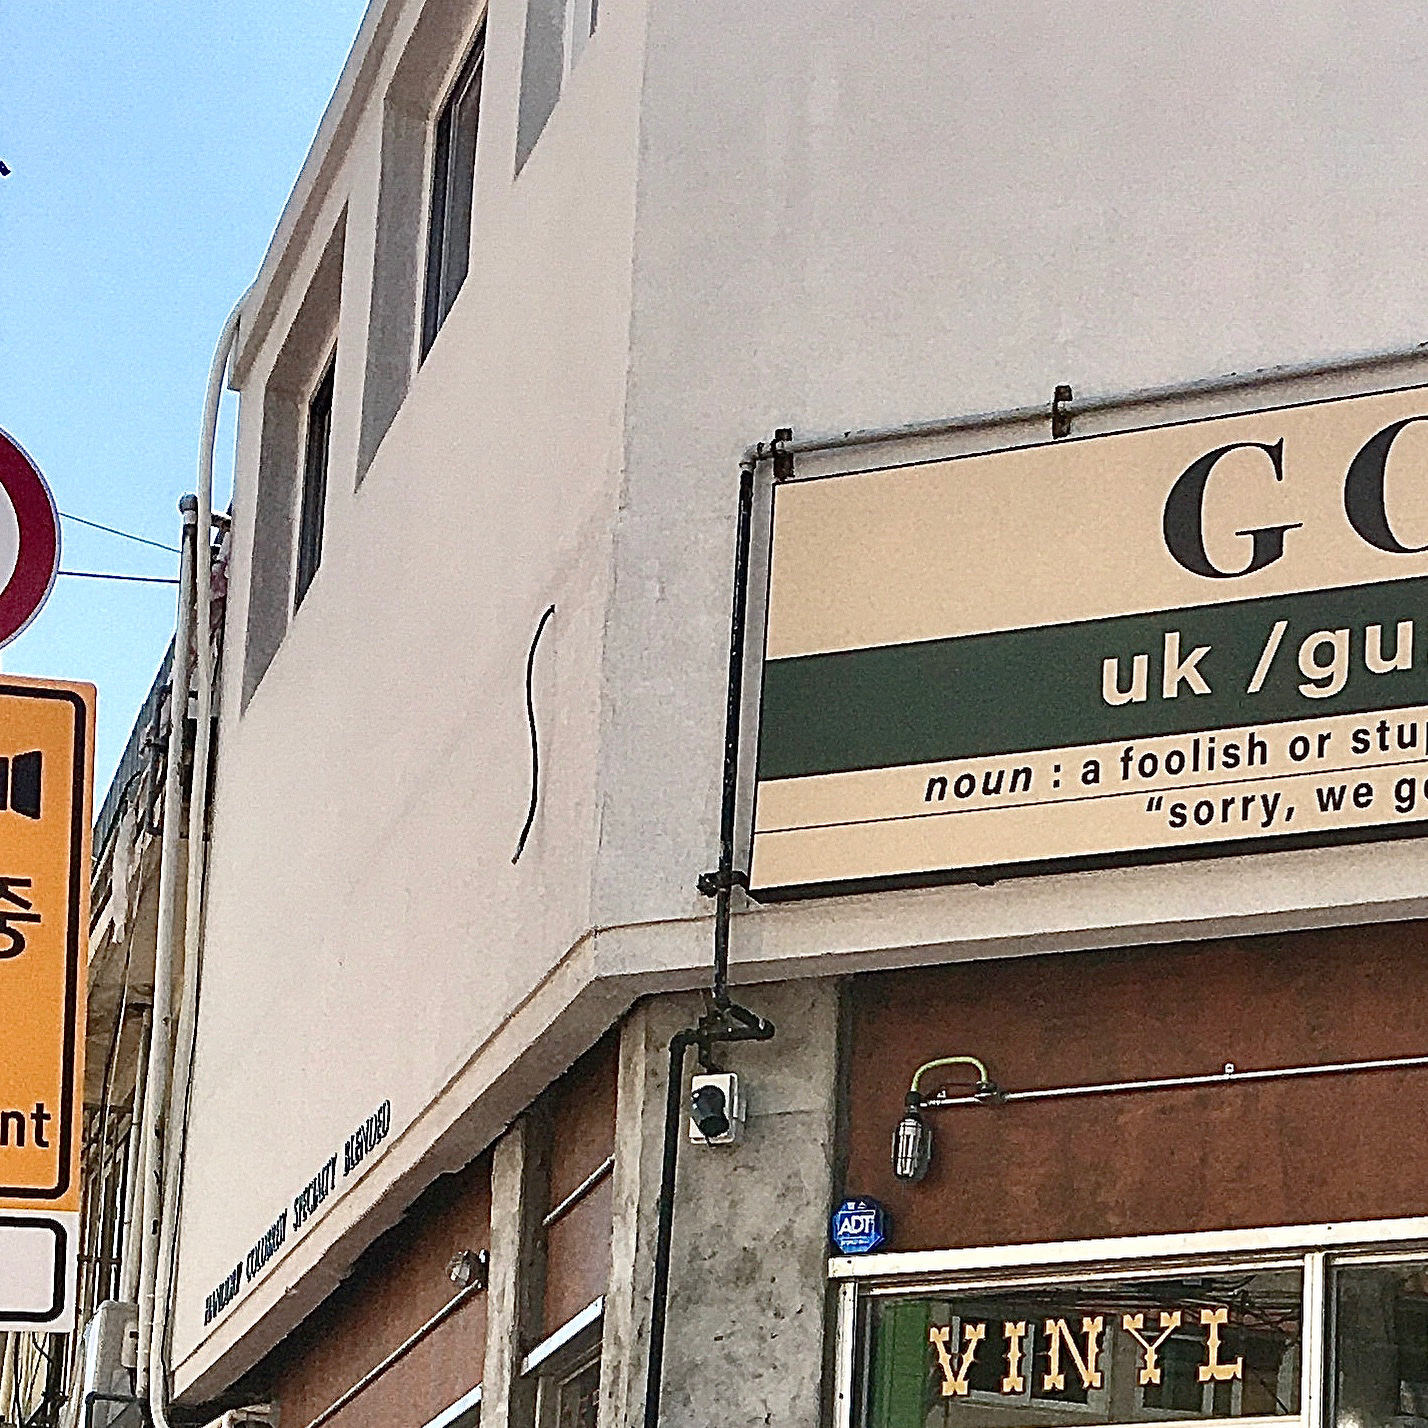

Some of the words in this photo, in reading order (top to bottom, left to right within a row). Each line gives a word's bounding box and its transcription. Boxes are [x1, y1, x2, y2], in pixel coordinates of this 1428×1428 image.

[1101, 631, 1212, 707] uk
[925, 764, 1034, 803] noun
[1081, 757, 1102, 786] a
[1121, 733, 1268, 782] foolish
[1288, 731, 1331, 760] or
[1317, 778, 1373, 812] we
[343, 1099, 390, 1177] BLENDED
[837, 1215, 875, 1235] ADT
[929, 1309, 1243, 1396] VINYL
